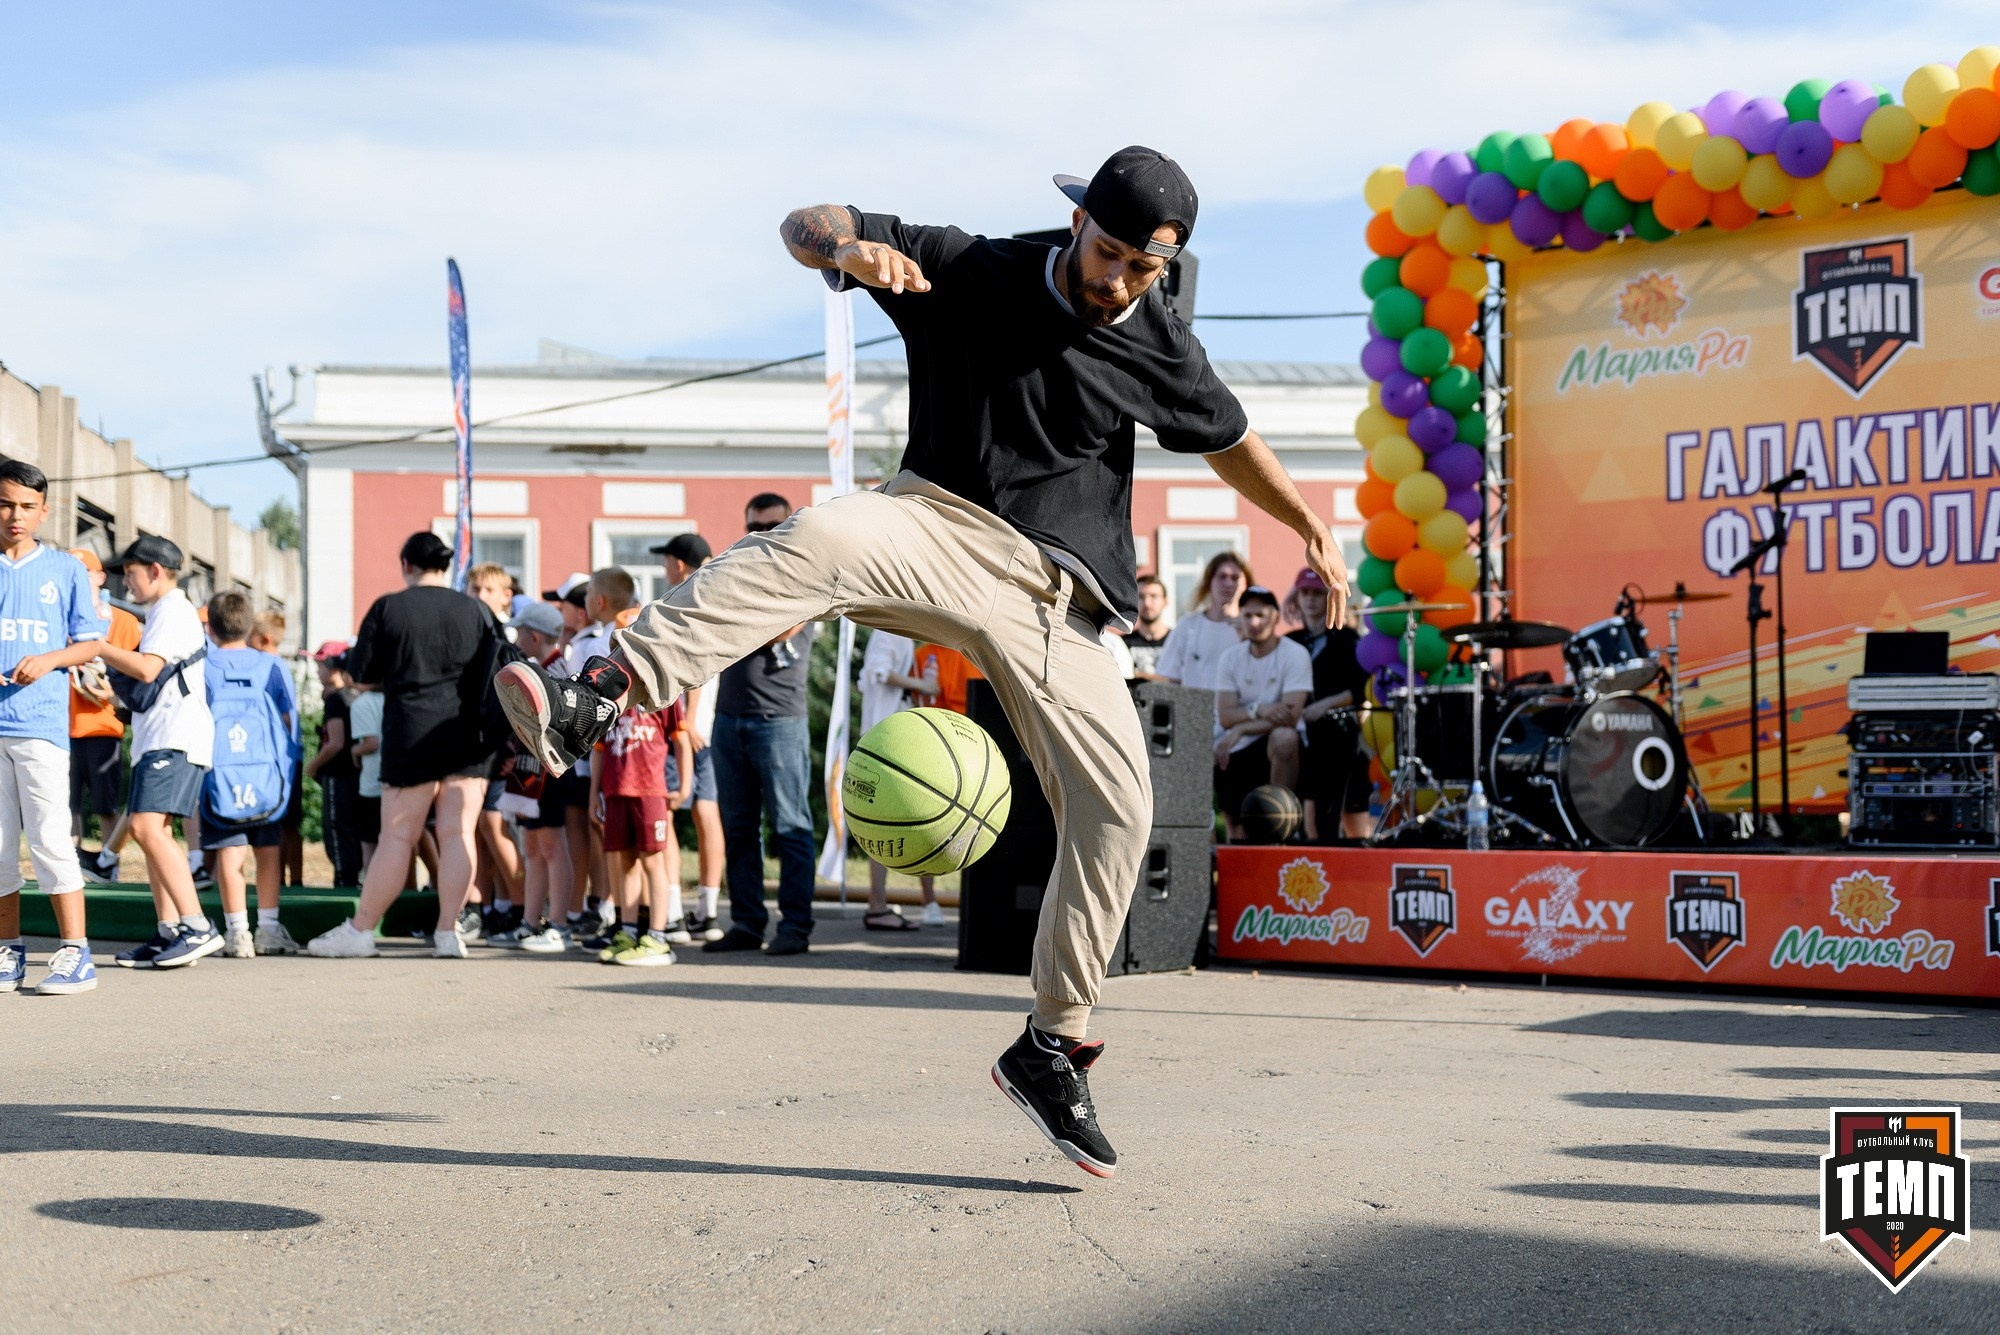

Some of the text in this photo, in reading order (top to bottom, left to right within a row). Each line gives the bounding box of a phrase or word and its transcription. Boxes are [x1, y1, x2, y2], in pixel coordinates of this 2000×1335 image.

[1803, 283, 1911, 344] ТЕМП
[1559, 330, 1748, 391] МарияРа
[0, 618, 49, 643] ВТБ
[1607, 713, 1653, 732] YAMAHA
[232, 783, 258, 810] 14
[1395, 889, 1450, 924] ТЕМП
[1484, 896, 1634, 931] GALAXY
[1673, 899, 1738, 936] ТЕМП
[1233, 905, 1370, 945] МарияРа
[1770, 926, 1955, 973] МарияРа
